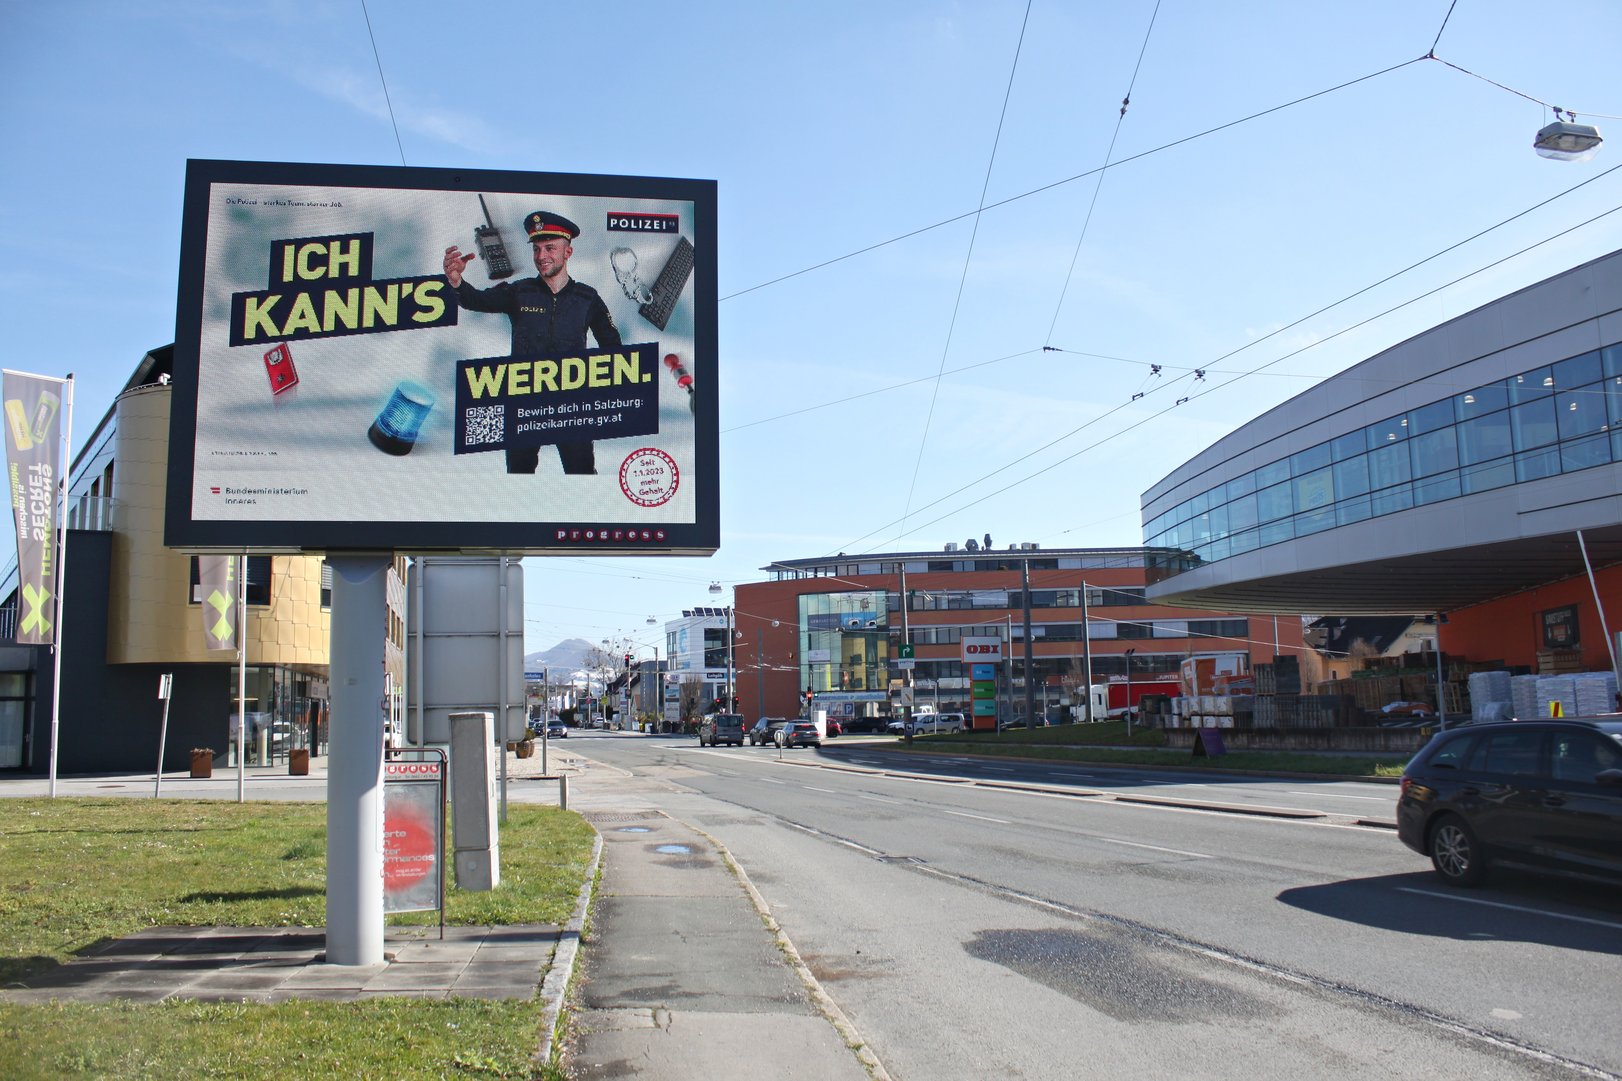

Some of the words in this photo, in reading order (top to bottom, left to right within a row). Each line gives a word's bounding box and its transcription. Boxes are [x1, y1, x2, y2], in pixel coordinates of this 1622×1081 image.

[609, 217, 668, 231] POLIZEI
[282, 239, 361, 283] ICH
[243, 280, 446, 340] KANN'S
[464, 351, 653, 400] WERDEN.
[517, 405, 555, 418] Bewirb
[557, 402, 579, 414] dich
[582, 401, 592, 411] in
[594, 398, 644, 410] Salzburg:
[516, 412, 622, 434] polizeikarriere.gv.at
[639, 458, 656, 467] Seit
[632, 467, 665, 477] 1.1.2023
[640, 477, 660, 486] mehr
[225, 487, 309, 495] Bundesministerium
[638, 486, 664, 496] Gehalt
[225, 497, 257, 505] Inneres
[556, 529, 667, 541] progress
[966, 644, 1000, 654] OBI
